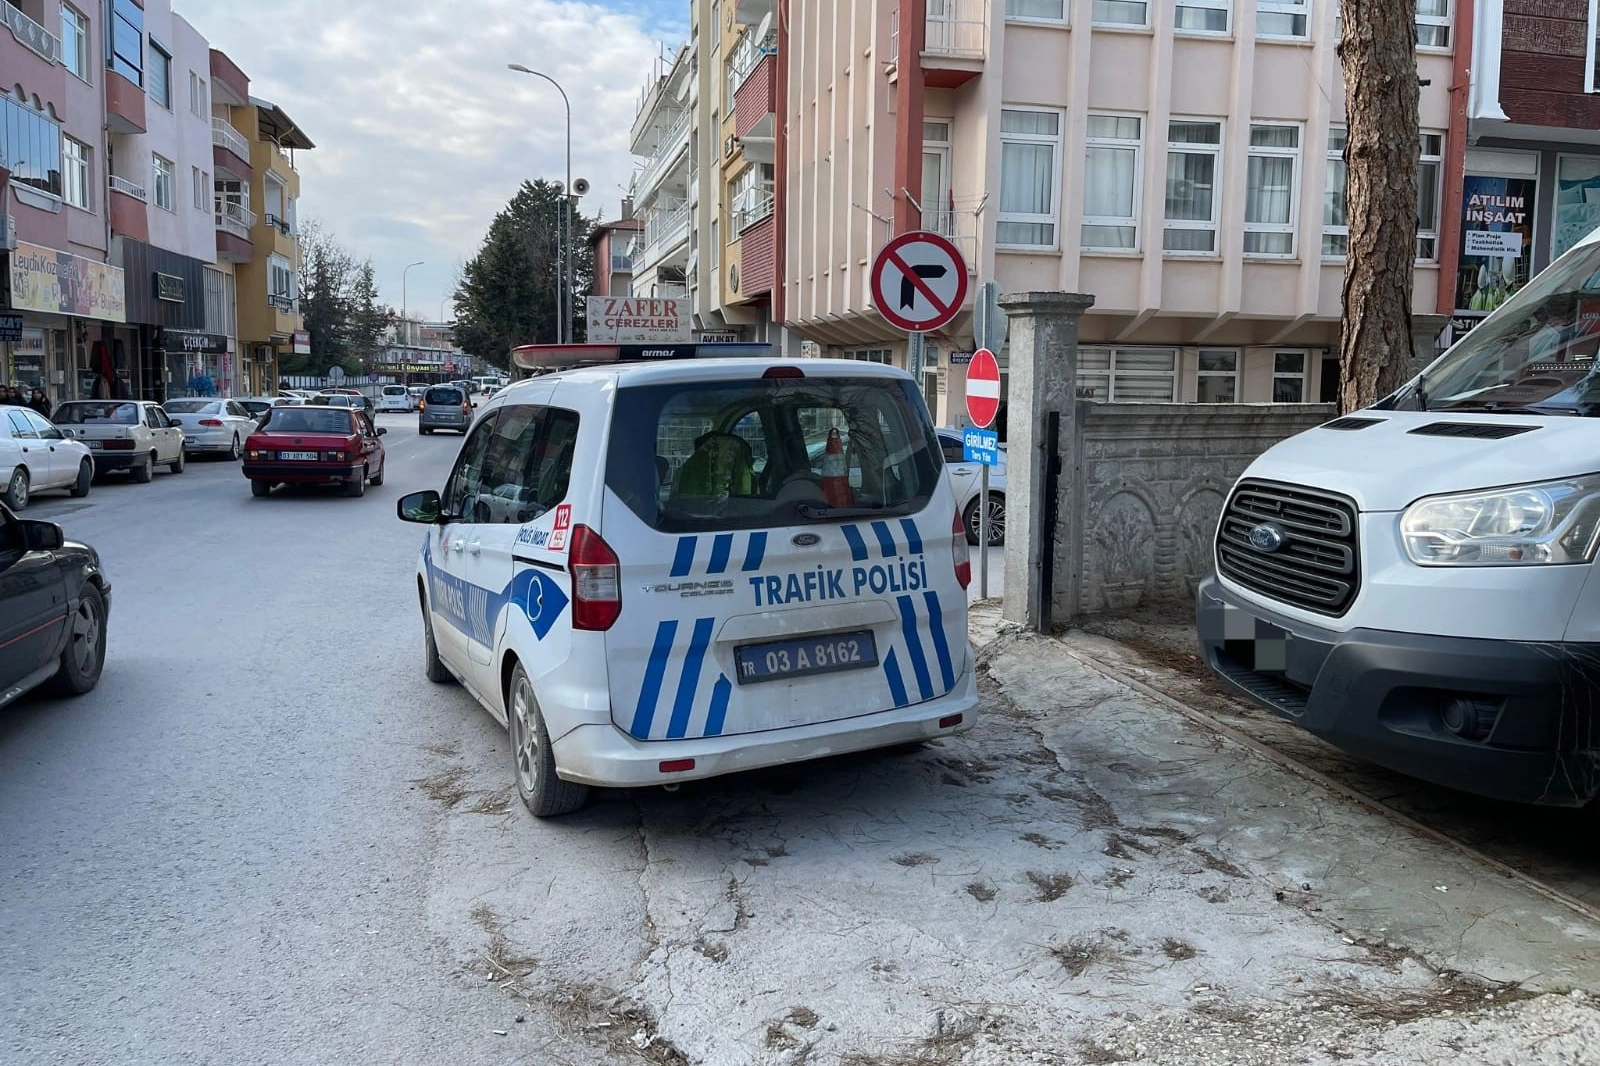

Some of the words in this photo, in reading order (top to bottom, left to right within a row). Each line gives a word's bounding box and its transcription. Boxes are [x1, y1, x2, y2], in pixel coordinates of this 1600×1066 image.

[1469, 194, 1524, 208] ATILIM
[1466, 207, 1526, 225] İNŞAAT
[604, 299, 678, 317] ZAFER
[604, 317, 679, 329] ÇEREZLERİ
[702, 335, 736, 343] AVUKAT
[965, 431, 996, 451] GİRİLMEZ
[557, 508, 569, 528] 112
[749, 564, 846, 607] TRAFİK
[852, 554, 928, 596] POLİSİ
[742, 661, 756, 676] TR
[766, 651, 791, 674] 03
[797, 647, 811, 669] A
[815, 640, 860, 667] 8162
